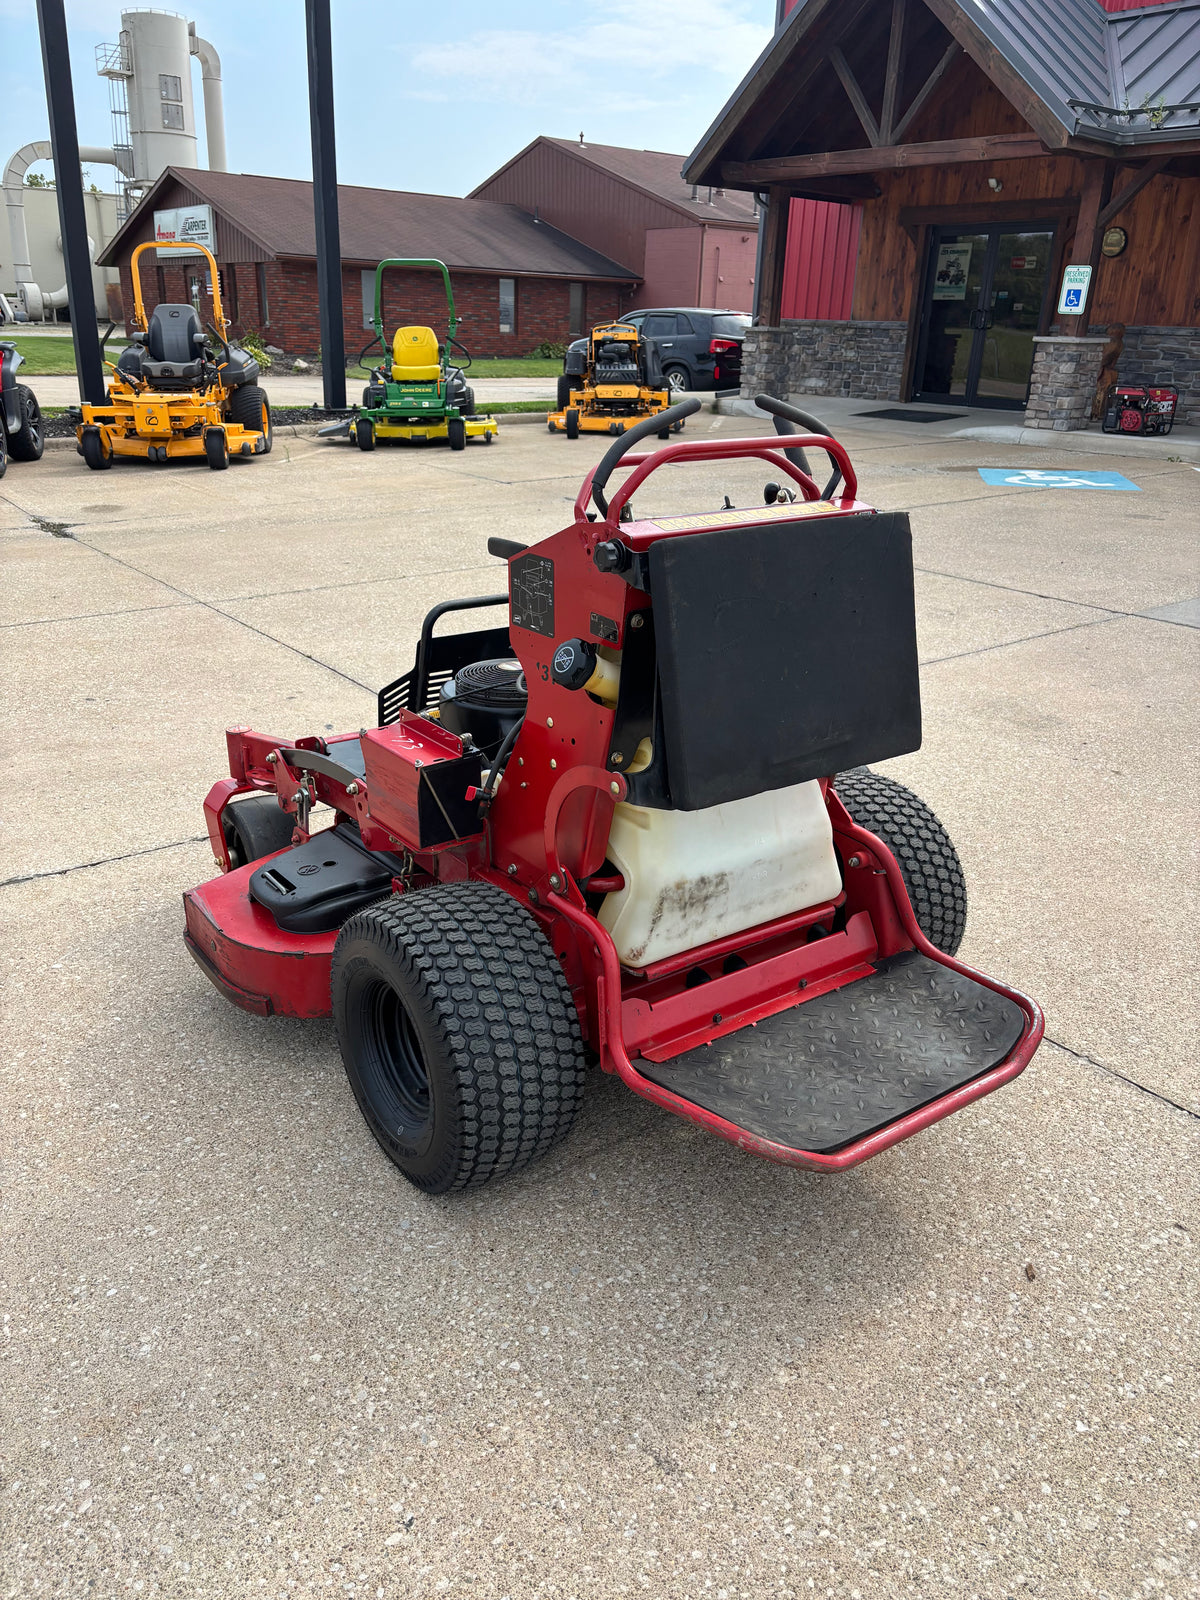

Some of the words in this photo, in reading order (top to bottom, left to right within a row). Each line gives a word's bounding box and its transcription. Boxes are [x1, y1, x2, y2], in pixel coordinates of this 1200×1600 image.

[157, 224, 175, 240] Amana
[185, 220, 207, 232] CARPENTER
[1066, 270, 1089, 278] RESERVED
